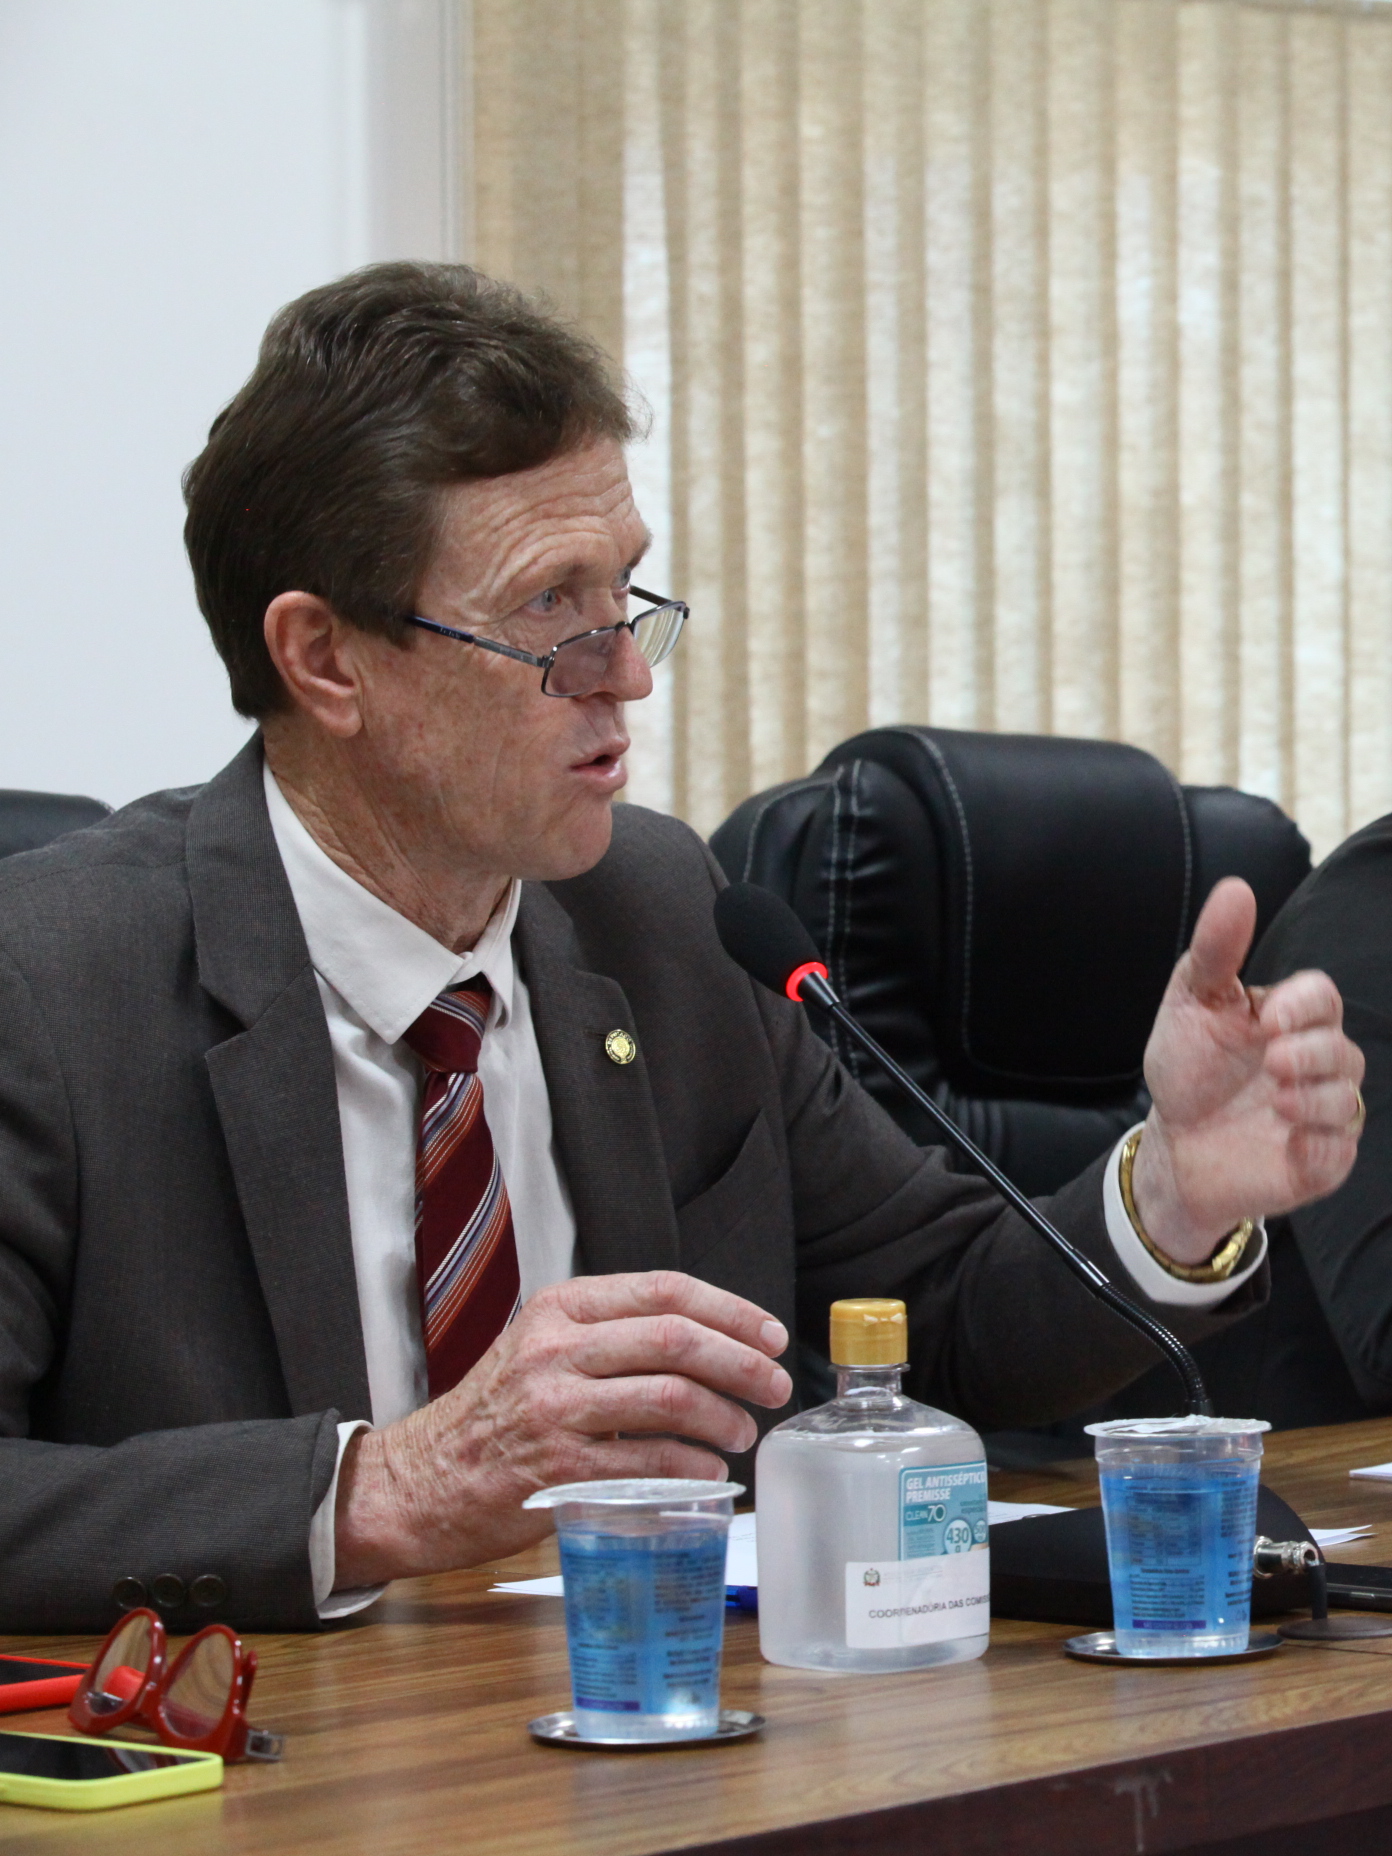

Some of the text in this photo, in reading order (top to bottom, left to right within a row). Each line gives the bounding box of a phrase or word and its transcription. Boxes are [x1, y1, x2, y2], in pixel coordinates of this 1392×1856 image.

[906, 1477, 923, 1490] GEL
[906, 1488, 951, 1503] PREMISSE
[928, 1504, 946, 1522] 70
[947, 1527, 969, 1544] 430
[948, 1599, 964, 1610] DAS
